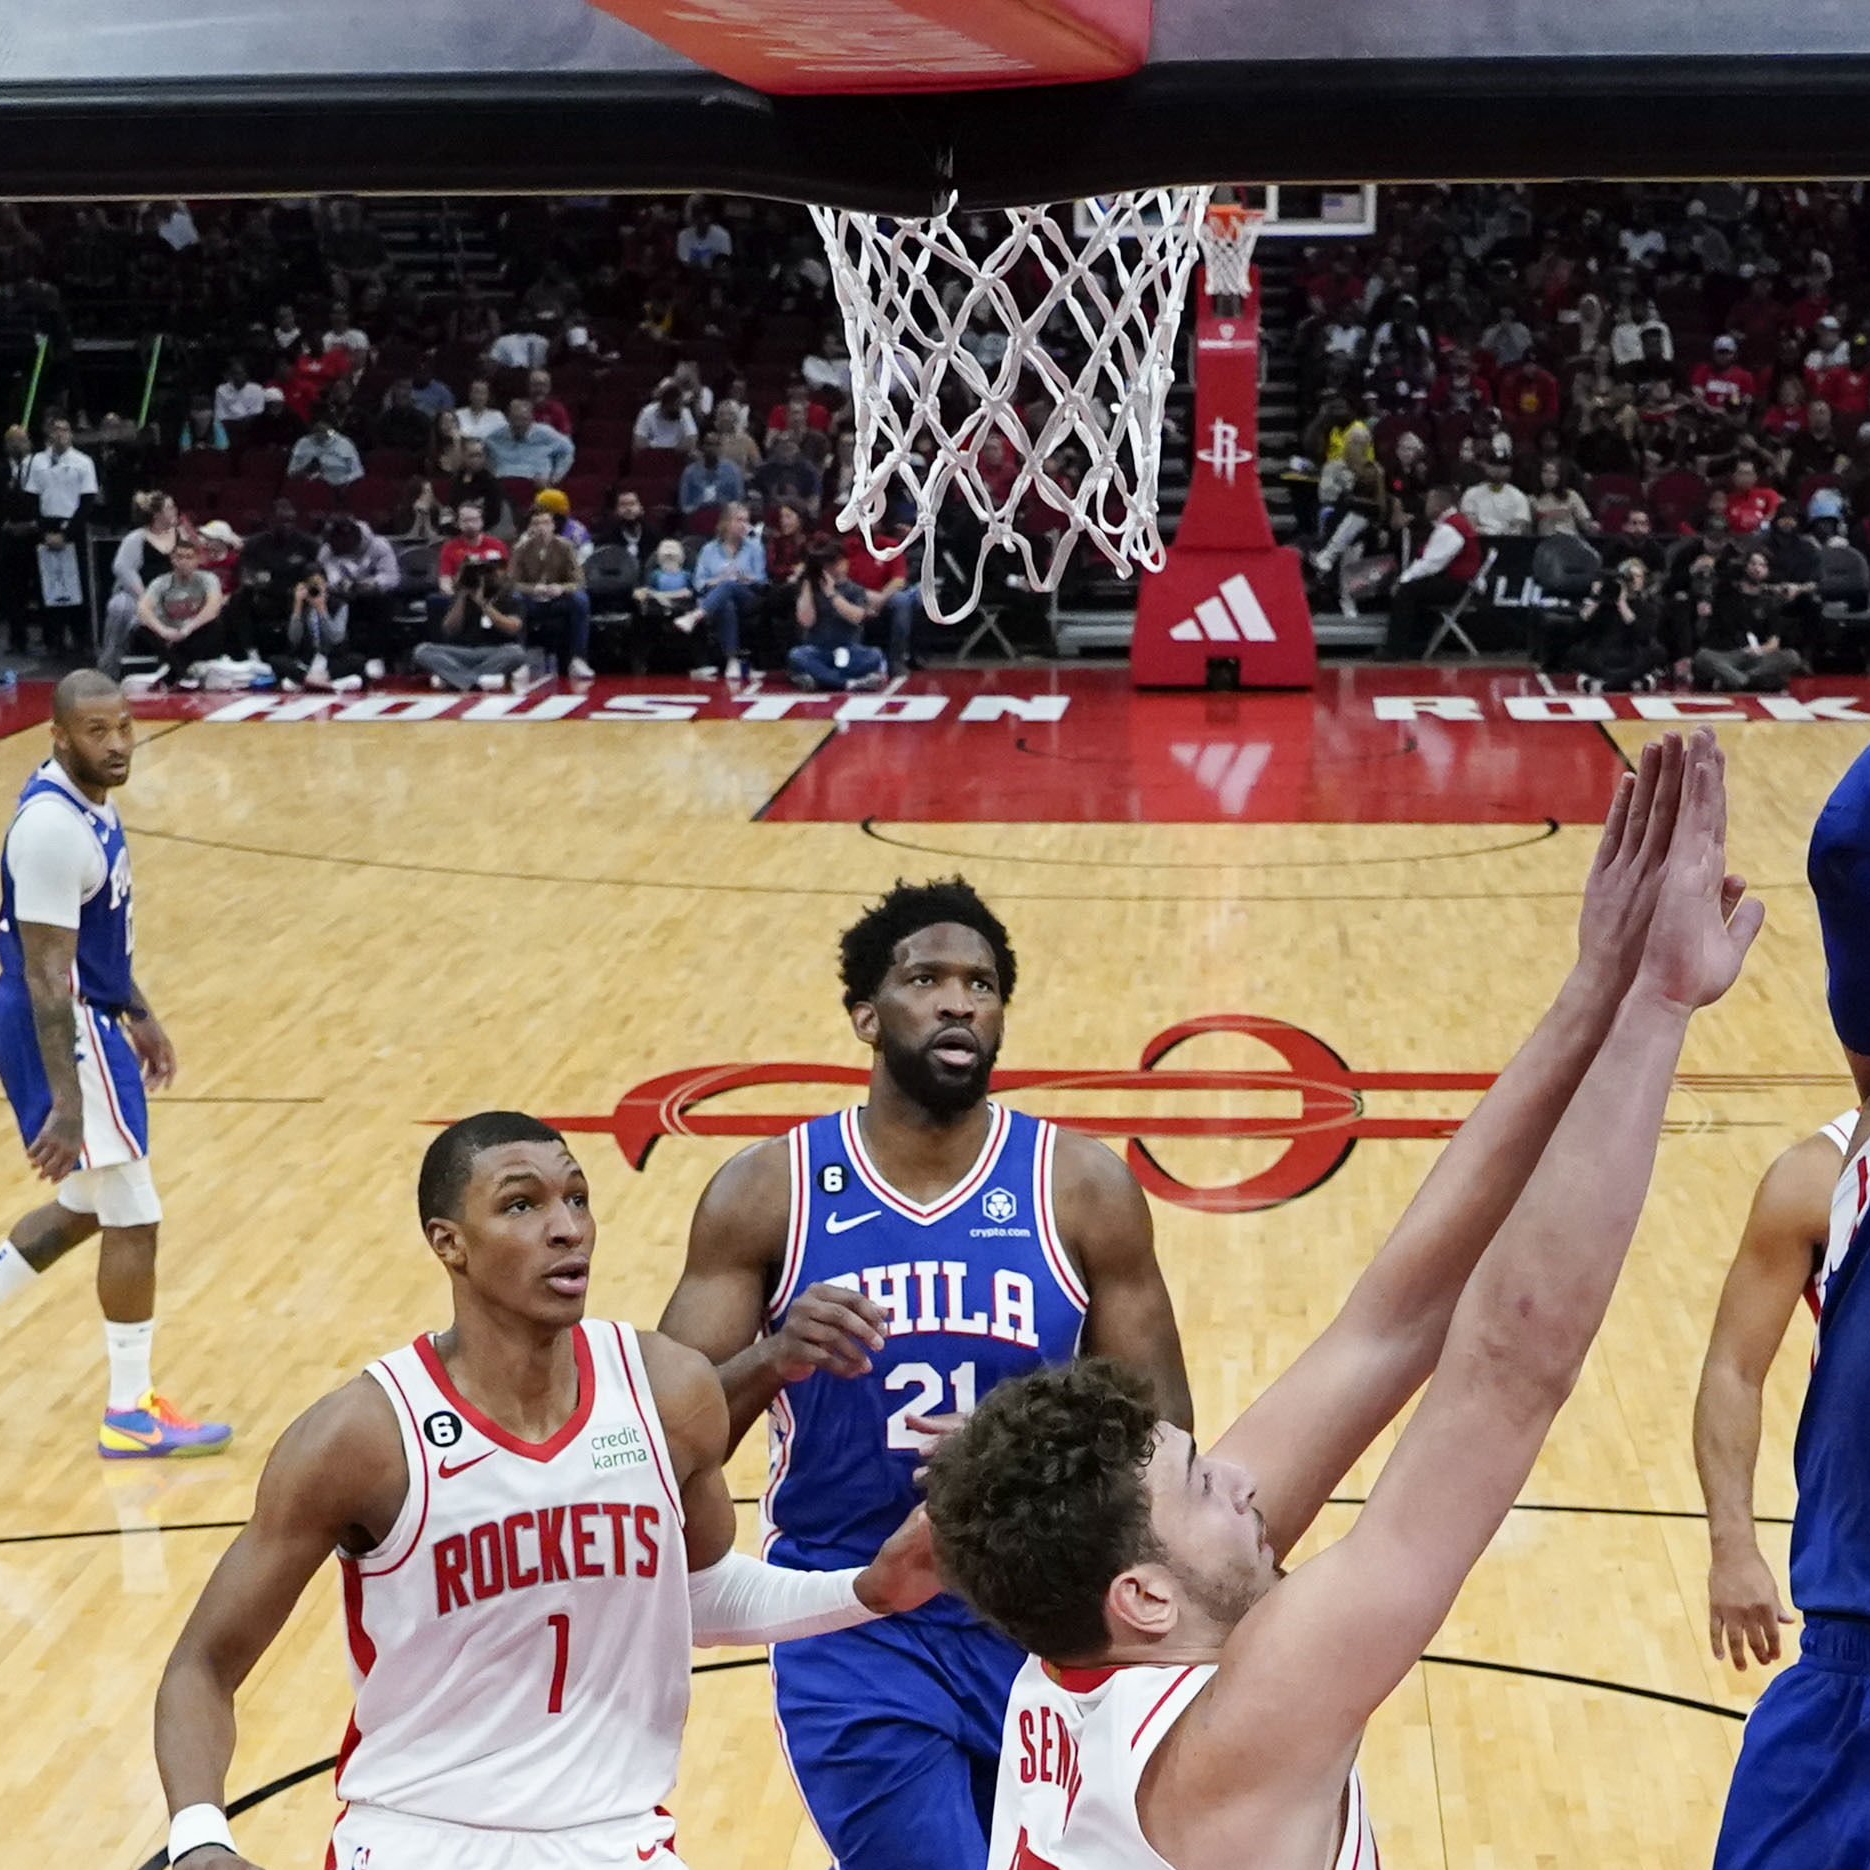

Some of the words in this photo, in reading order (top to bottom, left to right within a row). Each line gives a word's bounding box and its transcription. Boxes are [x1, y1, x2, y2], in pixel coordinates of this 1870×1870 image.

[203, 694, 1071, 722] HOUSTON
[823, 1166, 844, 1192] 6
[969, 1227, 1031, 1238] crypto.com
[824, 1260, 1040, 1349] HILA
[430, 1414, 456, 1445] 6
[591, 1426, 641, 1451] credit
[592, 1447, 648, 1470] karma
[432, 1502, 660, 1618] ROCKETS
[547, 1613, 570, 1714] 1
